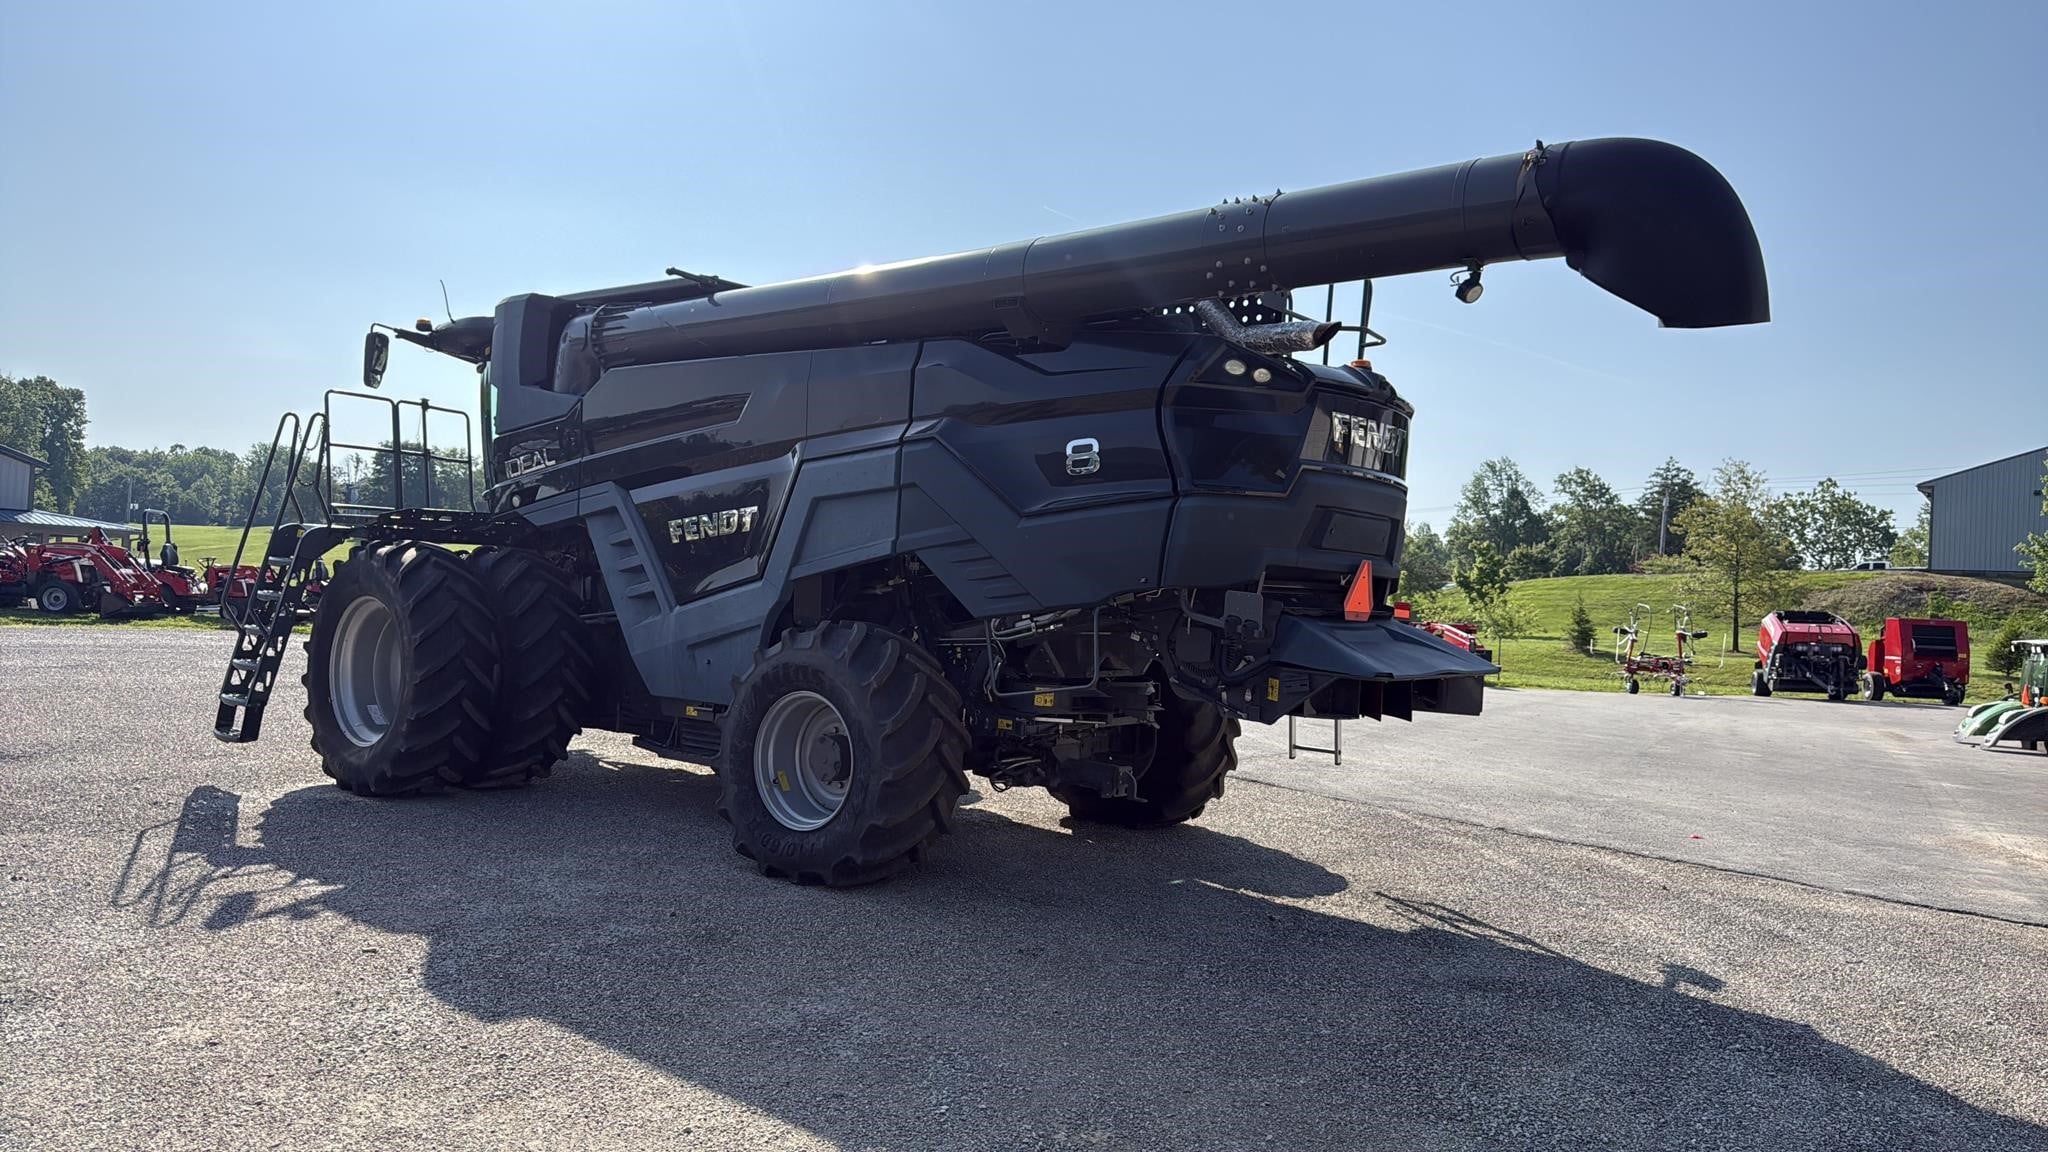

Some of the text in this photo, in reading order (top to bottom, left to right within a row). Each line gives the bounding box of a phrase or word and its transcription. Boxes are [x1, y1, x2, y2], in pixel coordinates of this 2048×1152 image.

[1332, 411, 1407, 457] FENDT
[504, 448, 556, 479] IDEAL
[1066, 437, 1100, 475] 8
[668, 505, 759, 544] FENDT
